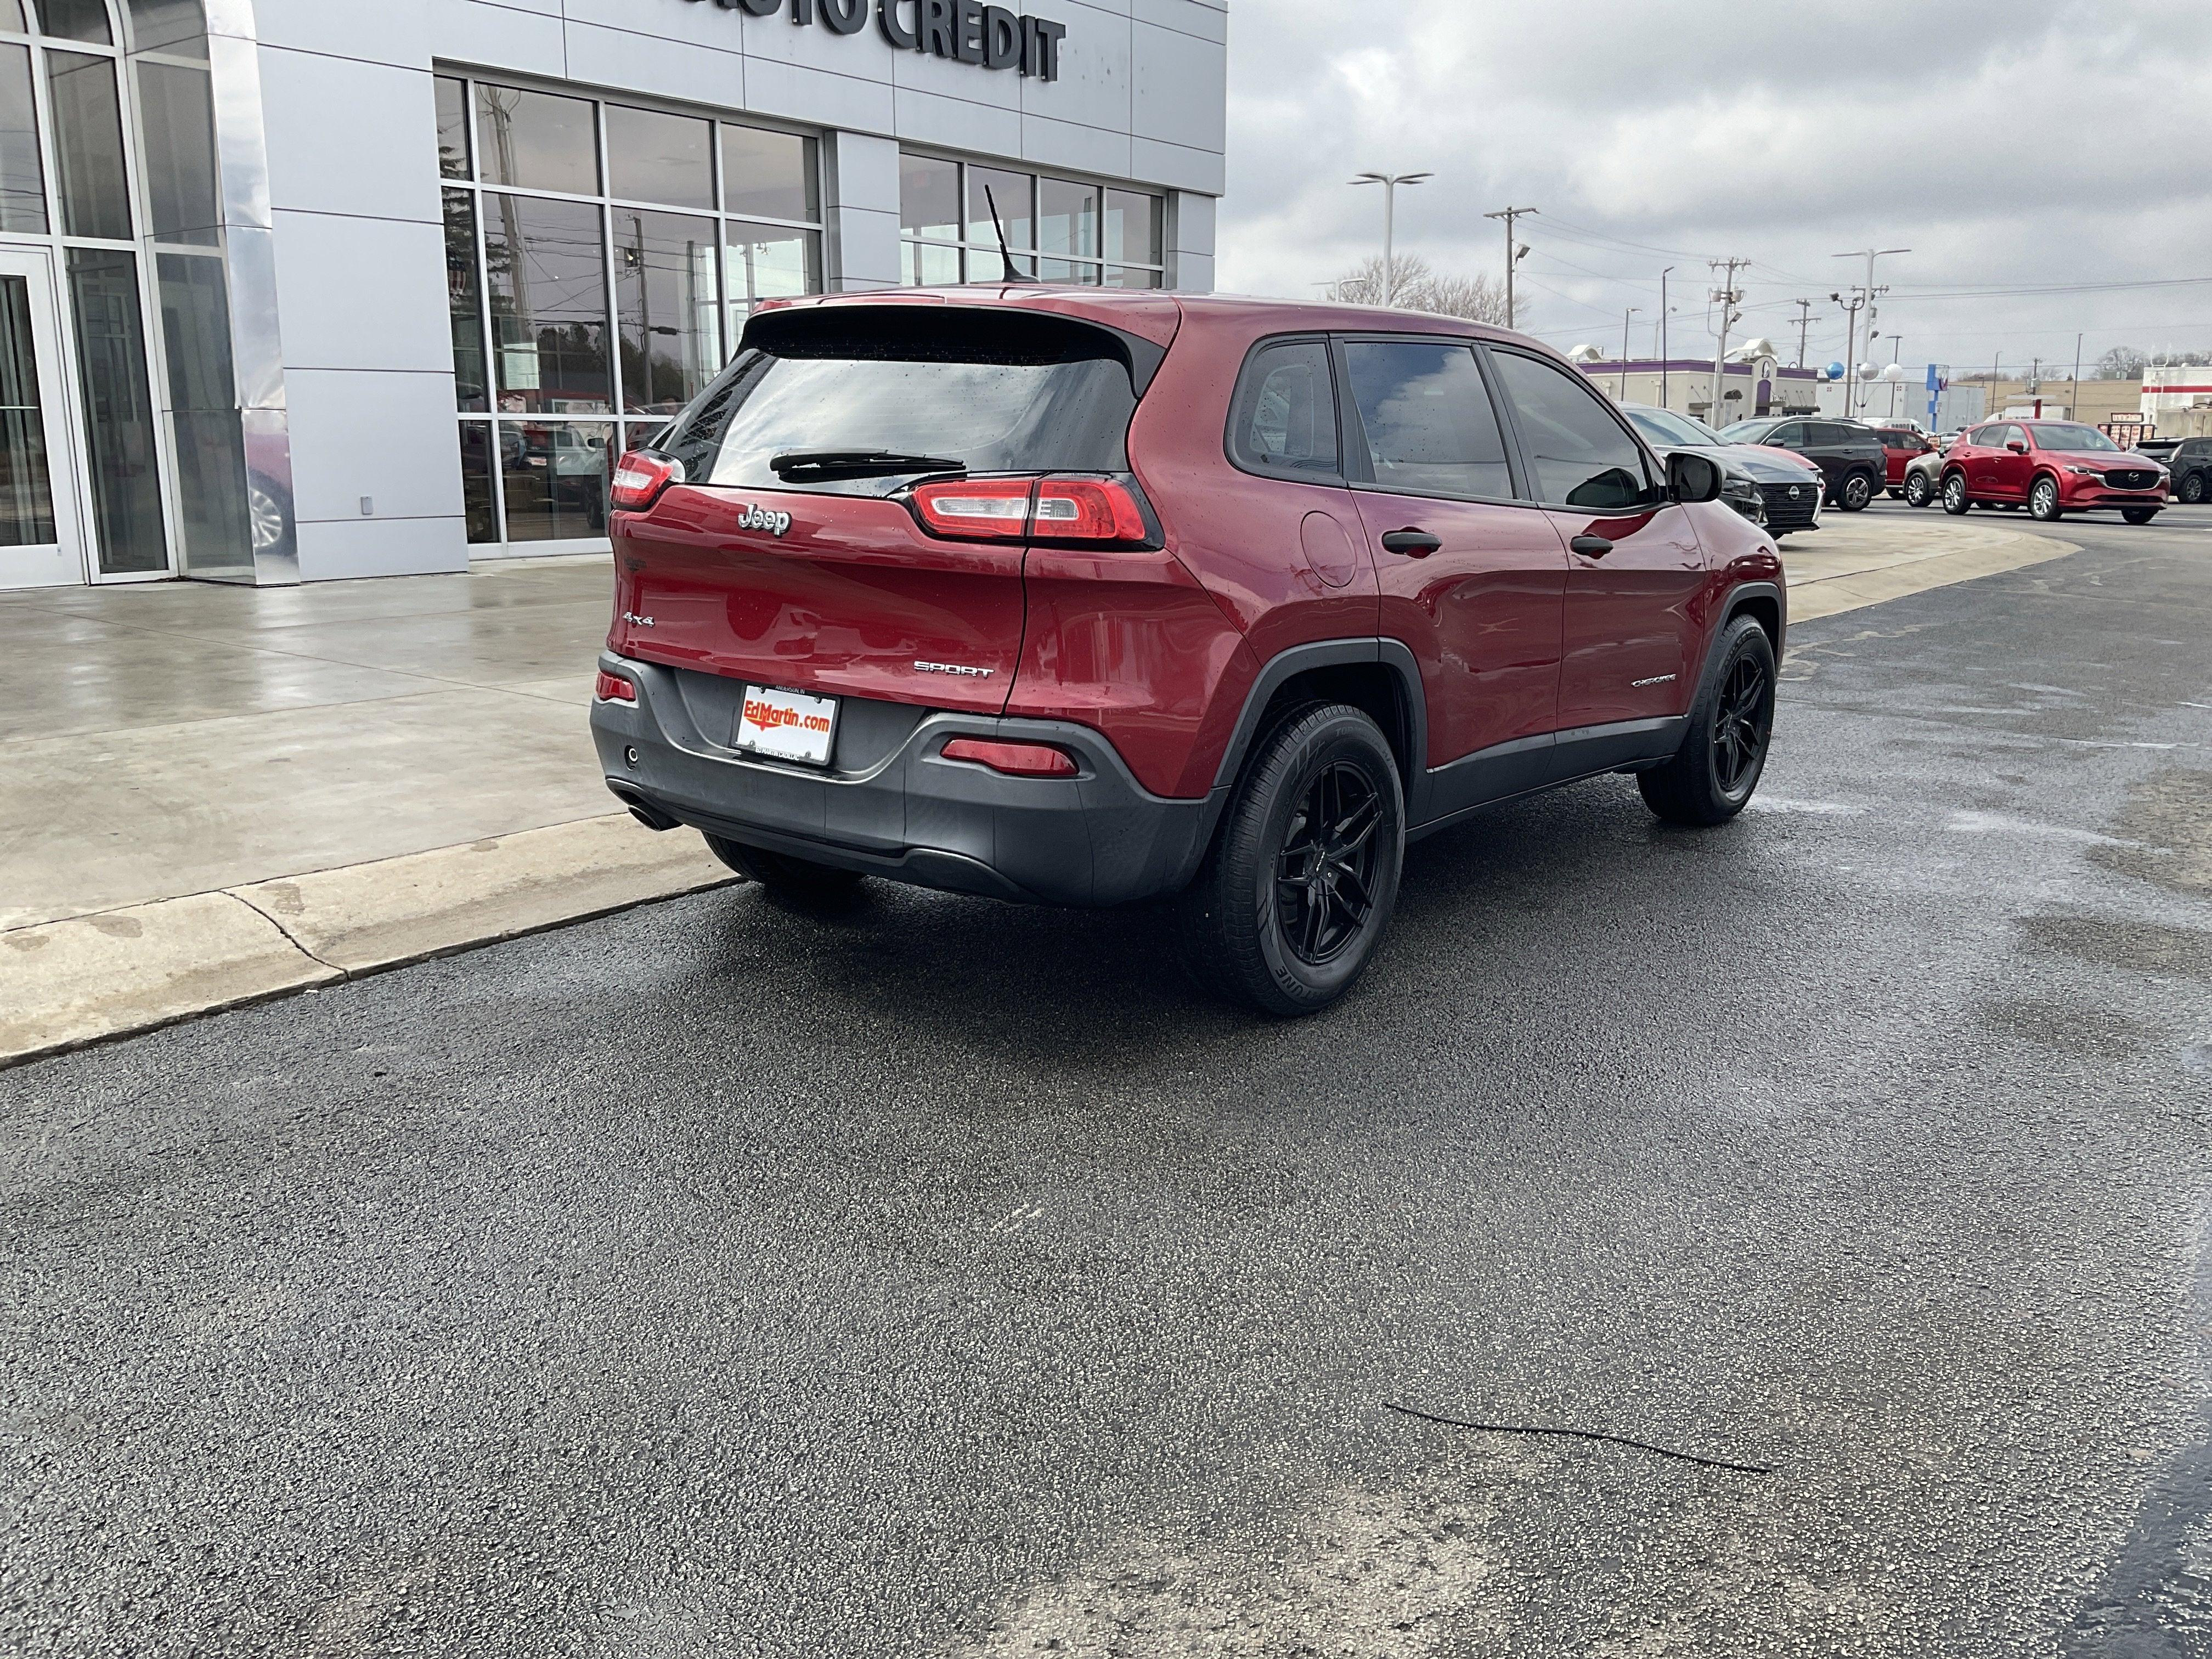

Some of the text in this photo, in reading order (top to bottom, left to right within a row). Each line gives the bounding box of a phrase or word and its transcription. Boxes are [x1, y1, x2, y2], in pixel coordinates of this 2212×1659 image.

[877, 0, 1066, 82] CREDIT
[738, 503, 792, 537] Jeep
[623, 611, 655, 628] 4x4
[913, 661, 995, 679] SPORT
[743, 699, 831, 732] EdMartin.com
[761, 748, 778, 757] MARTIN
[778, 751, 800, 761] CADILLAC
